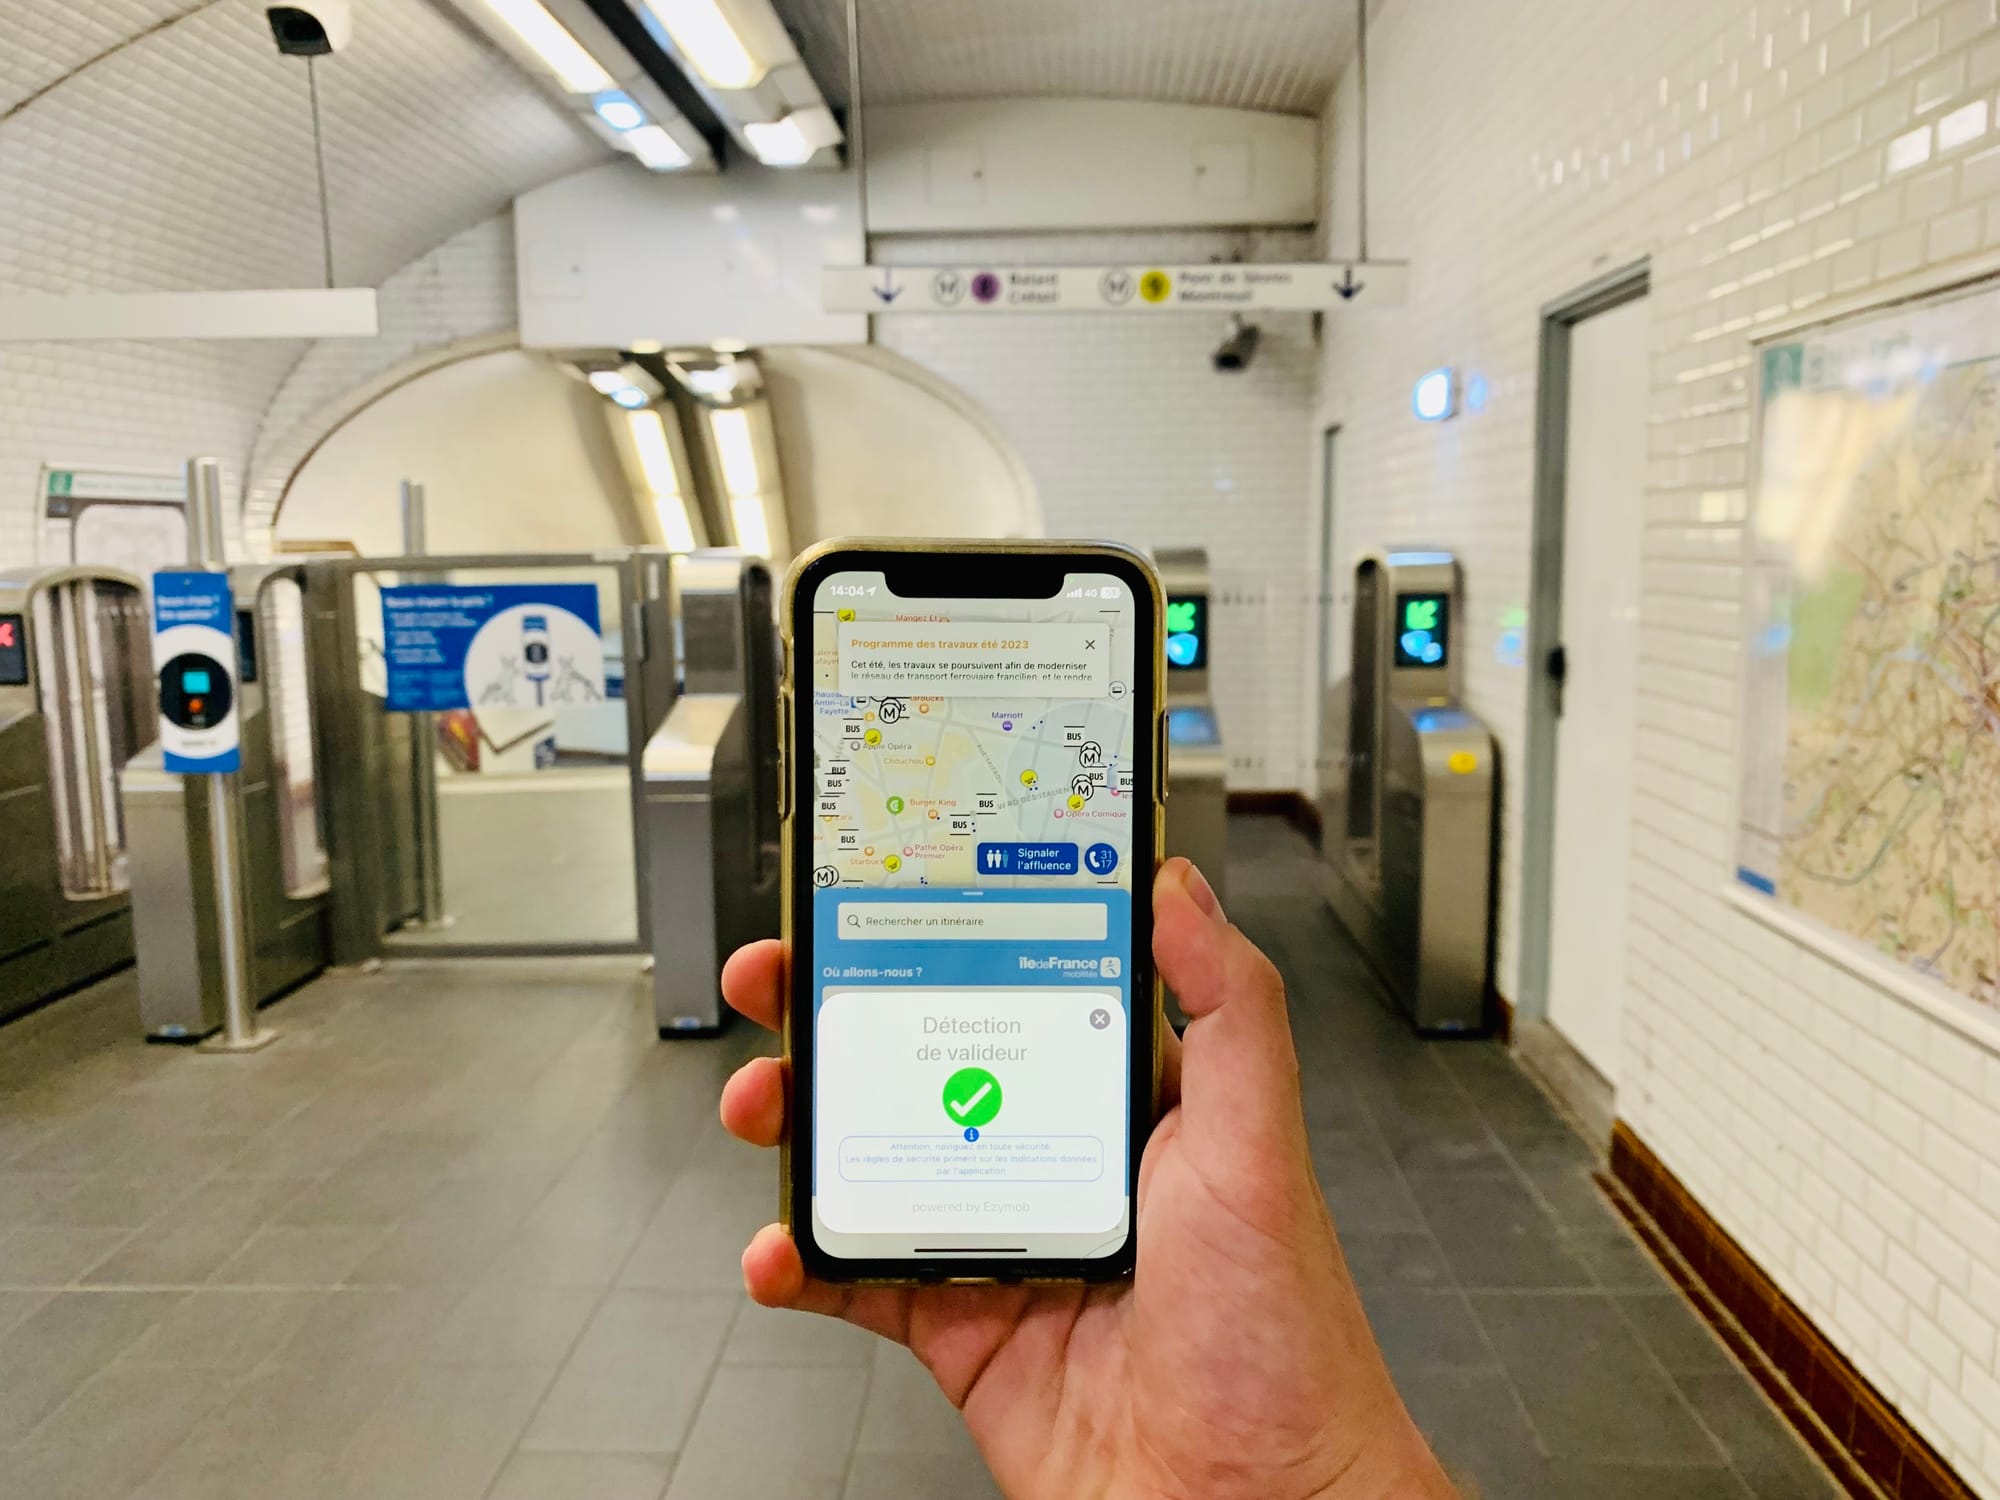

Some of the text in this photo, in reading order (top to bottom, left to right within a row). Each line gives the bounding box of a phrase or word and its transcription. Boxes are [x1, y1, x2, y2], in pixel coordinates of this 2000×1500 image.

[830, 585, 864, 596] 14:04
[1085, 588, 1098, 598] 4G
[851, 639, 1029, 650] Programme des travaux été 2023
[851, 661, 866, 669] Cet
[869, 661, 886, 671] été,
[888, 661, 901, 669] les
[904, 661, 936, 670] travaux
[951, 661, 1003, 672] poursuivent
[1005, 661, 1022, 670] afin
[1024, 661, 1035, 670] de
[1038, 661, 1087, 670] moderniser
[851, 672, 859, 680] le
[861, 672, 891, 680] réseau
[893, 672, 905, 680] de
[907, 672, 948, 681] transport
[950, 672, 994, 681] ferroviaire
[1042, 672, 1051, 681] et
[1053, 672, 1062, 681] le
[1064, 672, 1093, 681] rendre
[820, 708, 849, 716] Fayette
[991, 711, 1024, 719] Marriott
[845, 725, 860, 733] BUS
[1066, 733, 1082, 741] BUS
[831, 766, 847, 775] BUS
[1089, 772, 1104, 781] BUS
[827, 780, 842, 788] BUS
[821, 802, 836, 810] BUS
[910, 799, 957, 808] Burger King
[979, 800, 994, 808] BUS
[1092, 810, 1127, 819] Comique
[952, 821, 968, 829] BUS
[840, 835, 856, 843] BUS
[914, 852, 945, 860] Premier
[1017, 848, 1060, 860] Signaler
[1100, 850, 1113, 860] 31
[1017, 860, 1072, 871] l'affluence
[1100, 859, 1112, 869] 17
[866, 916, 984, 926] Rechercher un itinéraire
[823, 967, 923, 978] Où allons-nous ?
[1063, 969, 1098, 978] mobilités
[923, 1016, 1022, 1034] Détection
[916, 1043, 1028, 1061] de valideur
[890, 1143, 933, 1152] Attention,
[935, 1143, 973, 1153] naviguez
[990, 1143, 1012, 1151] toute
[1014, 1143, 1050, 1151] sécurité
[846, 1155, 860, 1163] Les
[863, 1154, 890, 1165] règles
[892, 1155, 903, 1163] de
[905, 1154, 941, 1163] sécurité
[943, 1155, 976, 1165] priment
[995, 1154, 1008, 1163] les
[1010, 1154, 1057, 1163] indications
[1060, 1154, 1097, 1163] données
[936, 1167, 1007, 1176] par l'application
[912, 1201, 1031, 1214] powered by Ezymob
